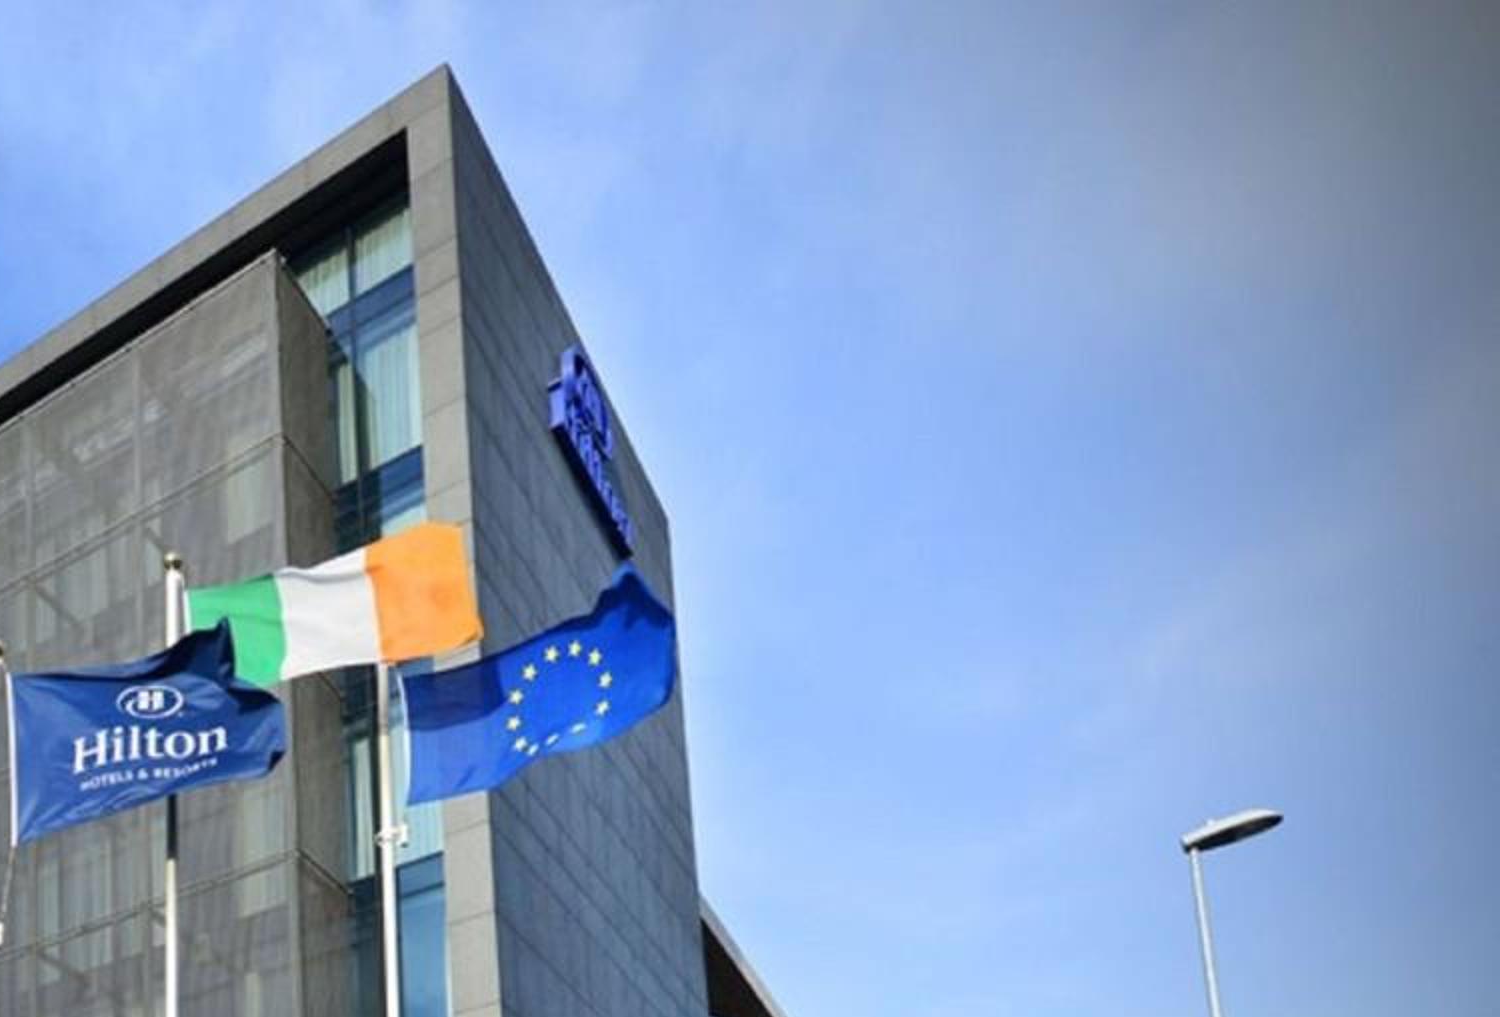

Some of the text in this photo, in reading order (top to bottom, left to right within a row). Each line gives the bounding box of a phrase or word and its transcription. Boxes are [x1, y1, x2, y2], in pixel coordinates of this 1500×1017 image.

[73, 725, 228, 775] Hilton
[79, 758, 218, 791] HOTELS & RESORTS
